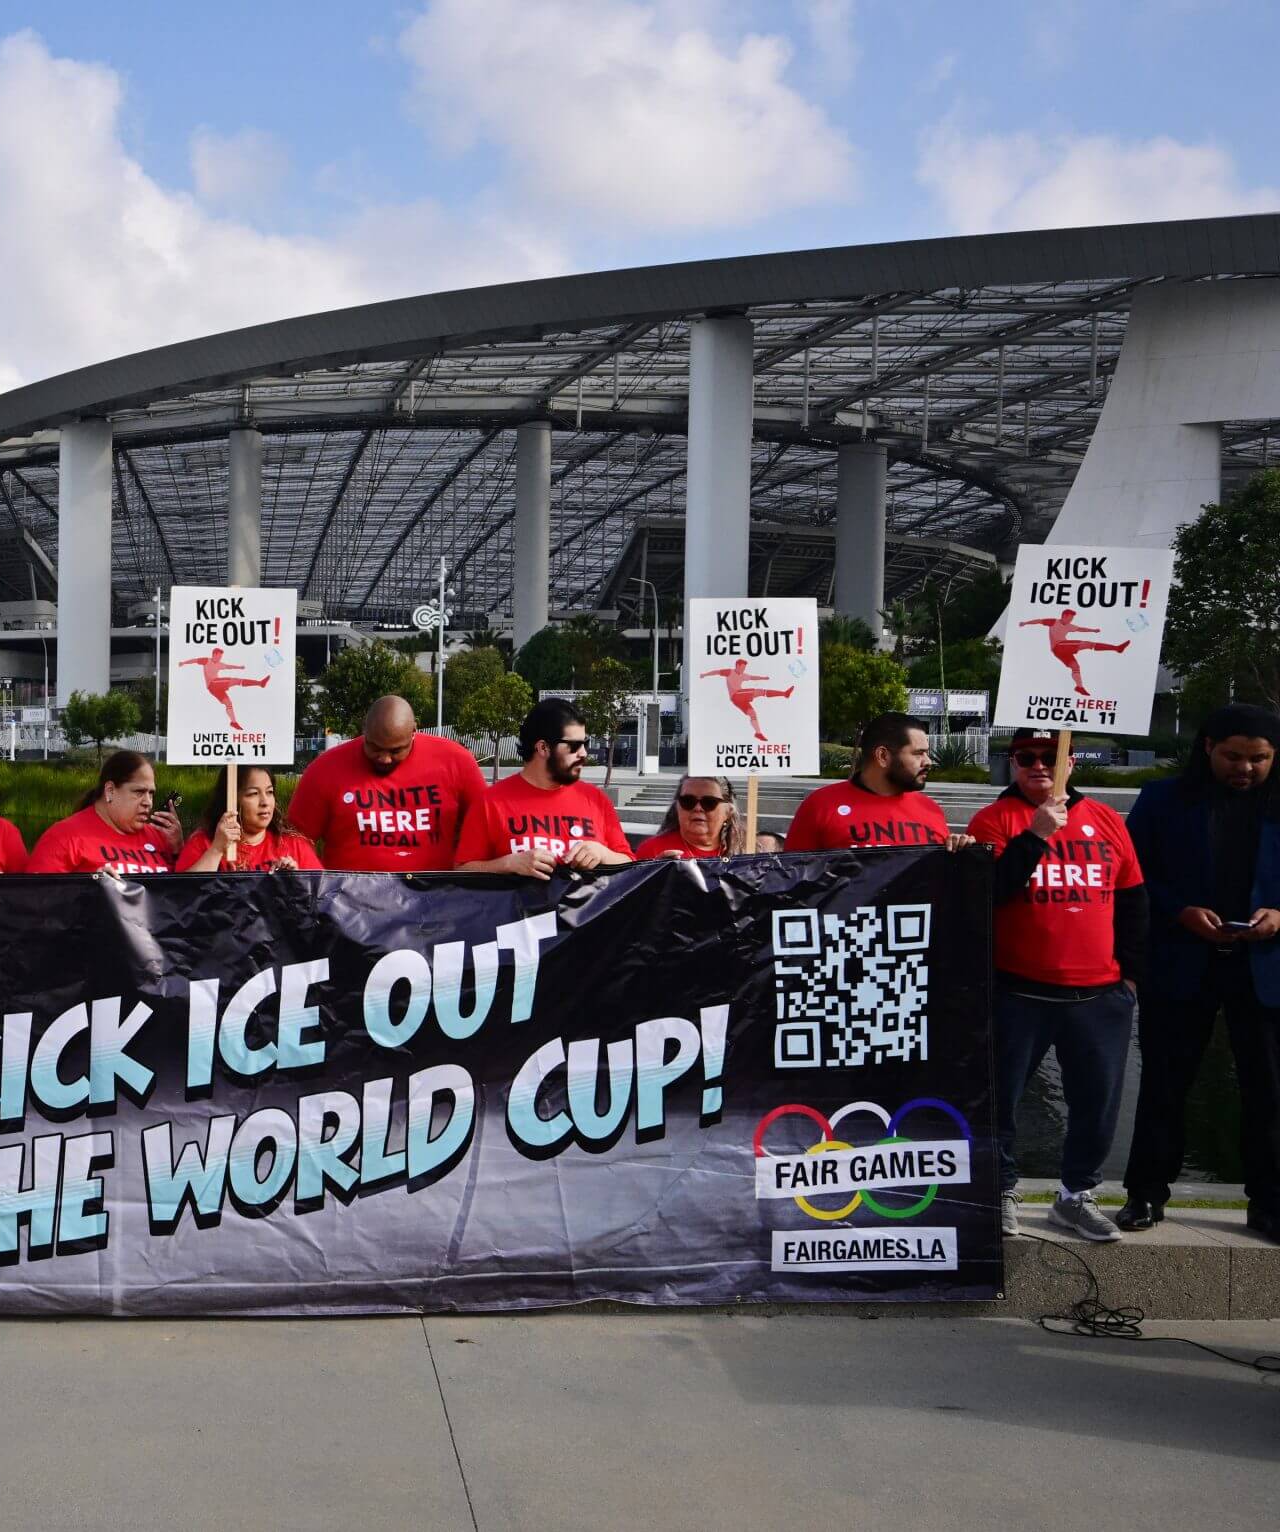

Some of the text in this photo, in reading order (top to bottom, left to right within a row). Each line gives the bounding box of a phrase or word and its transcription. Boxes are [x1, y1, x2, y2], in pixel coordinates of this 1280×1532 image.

[1046, 557, 1107, 580] KICK
[1030, 579, 1151, 608] ICE OUT!
[196, 597, 245, 620] KICK
[716, 607, 769, 632] KICK
[185, 617, 280, 646] ICE OUT!
[706, 627, 803, 657] ICE OUT!
[1028, 695, 1117, 711] UNITE HERE!
[1026, 706, 1116, 725] LOCAL 11
[193, 733, 266, 743] UNITE HERE!
[716, 744, 791, 754] UNITE HERE!
[193, 744, 266, 757] LOCAL 11
[716, 755, 791, 767] LOCAL 11
[355, 784, 442, 809] UNITE
[508, 815, 596, 838] UNITE
[360, 832, 420, 848] LOCAL
[1044, 840, 1114, 863] NITE
[186, 957, 330, 1099] ICE
[362, 912, 557, 1048] OUT
[141, 1064, 481, 1237] WORLD
[506, 1004, 730, 1161] CUP!
[775, 1150, 957, 1189] FAIR GAMES
[783, 1238, 946, 1263] FAIRGAMES.LA
